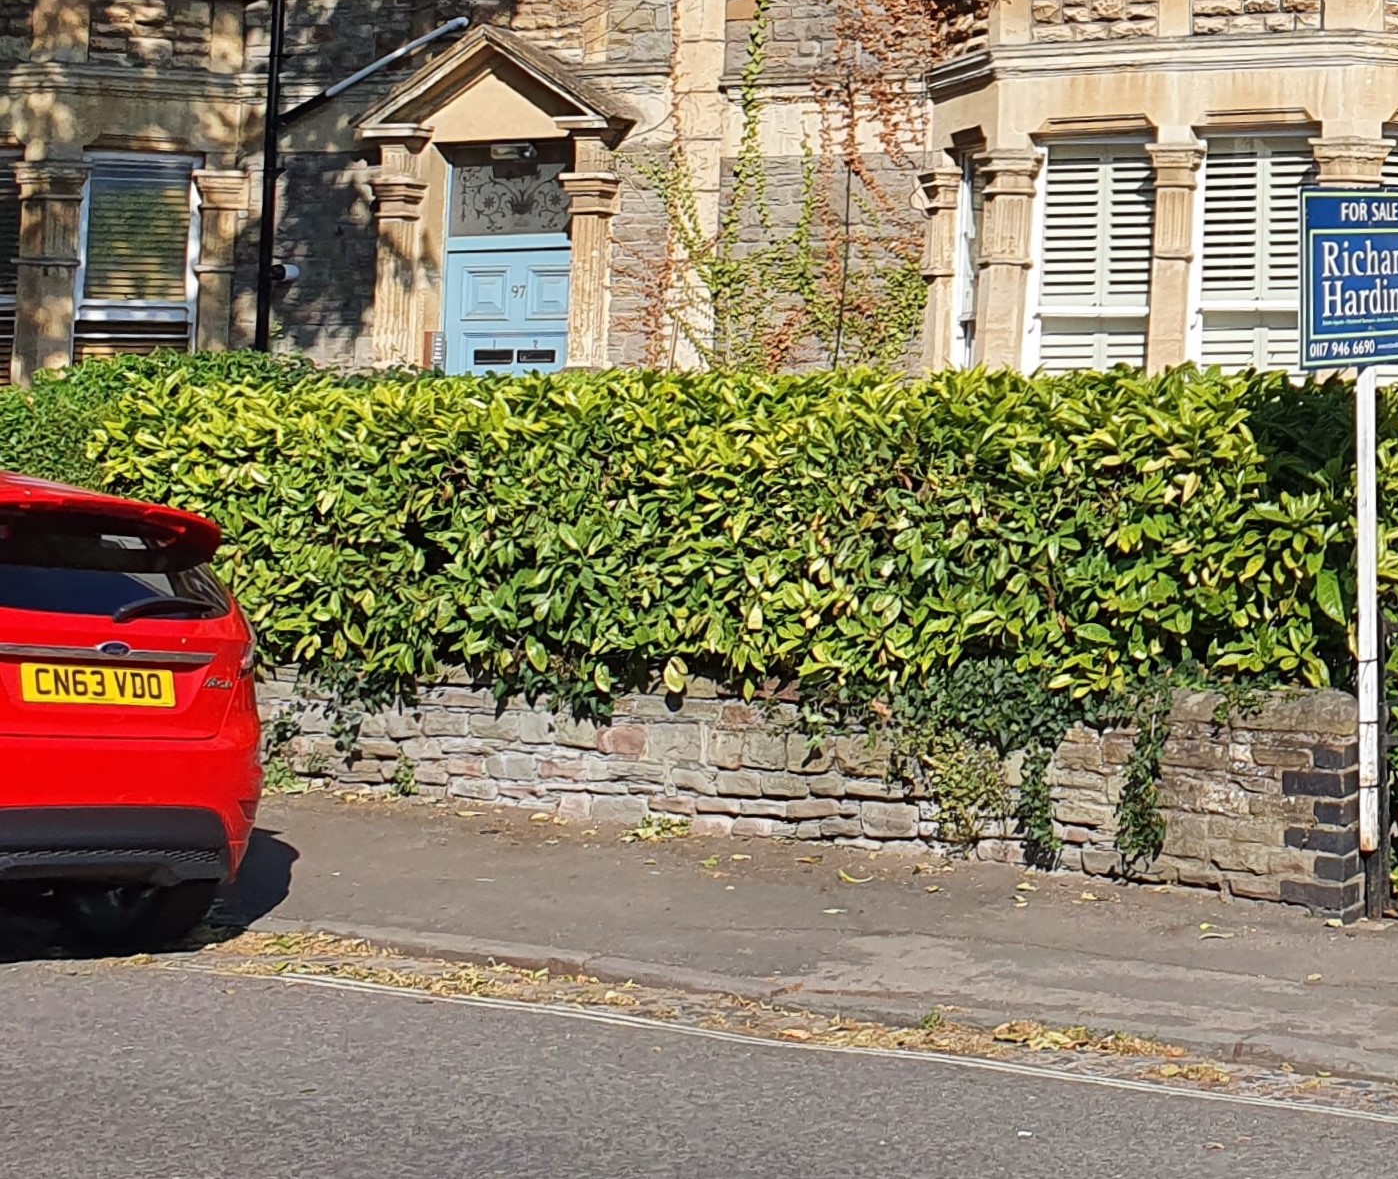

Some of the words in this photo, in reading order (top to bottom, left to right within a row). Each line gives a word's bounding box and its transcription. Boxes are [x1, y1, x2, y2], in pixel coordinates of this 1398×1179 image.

[1341, 202, 1368, 221] FOR
[1372, 202, 1398, 221] SALE
[511, 285, 526, 299] 97
[1309, 341, 1329, 358] 0117
[1331, 340, 1350, 357] 946
[1352, 339, 1376, 355] 6690
[35, 667, 105, 698] CN63
[113, 672, 162, 700] VDO
